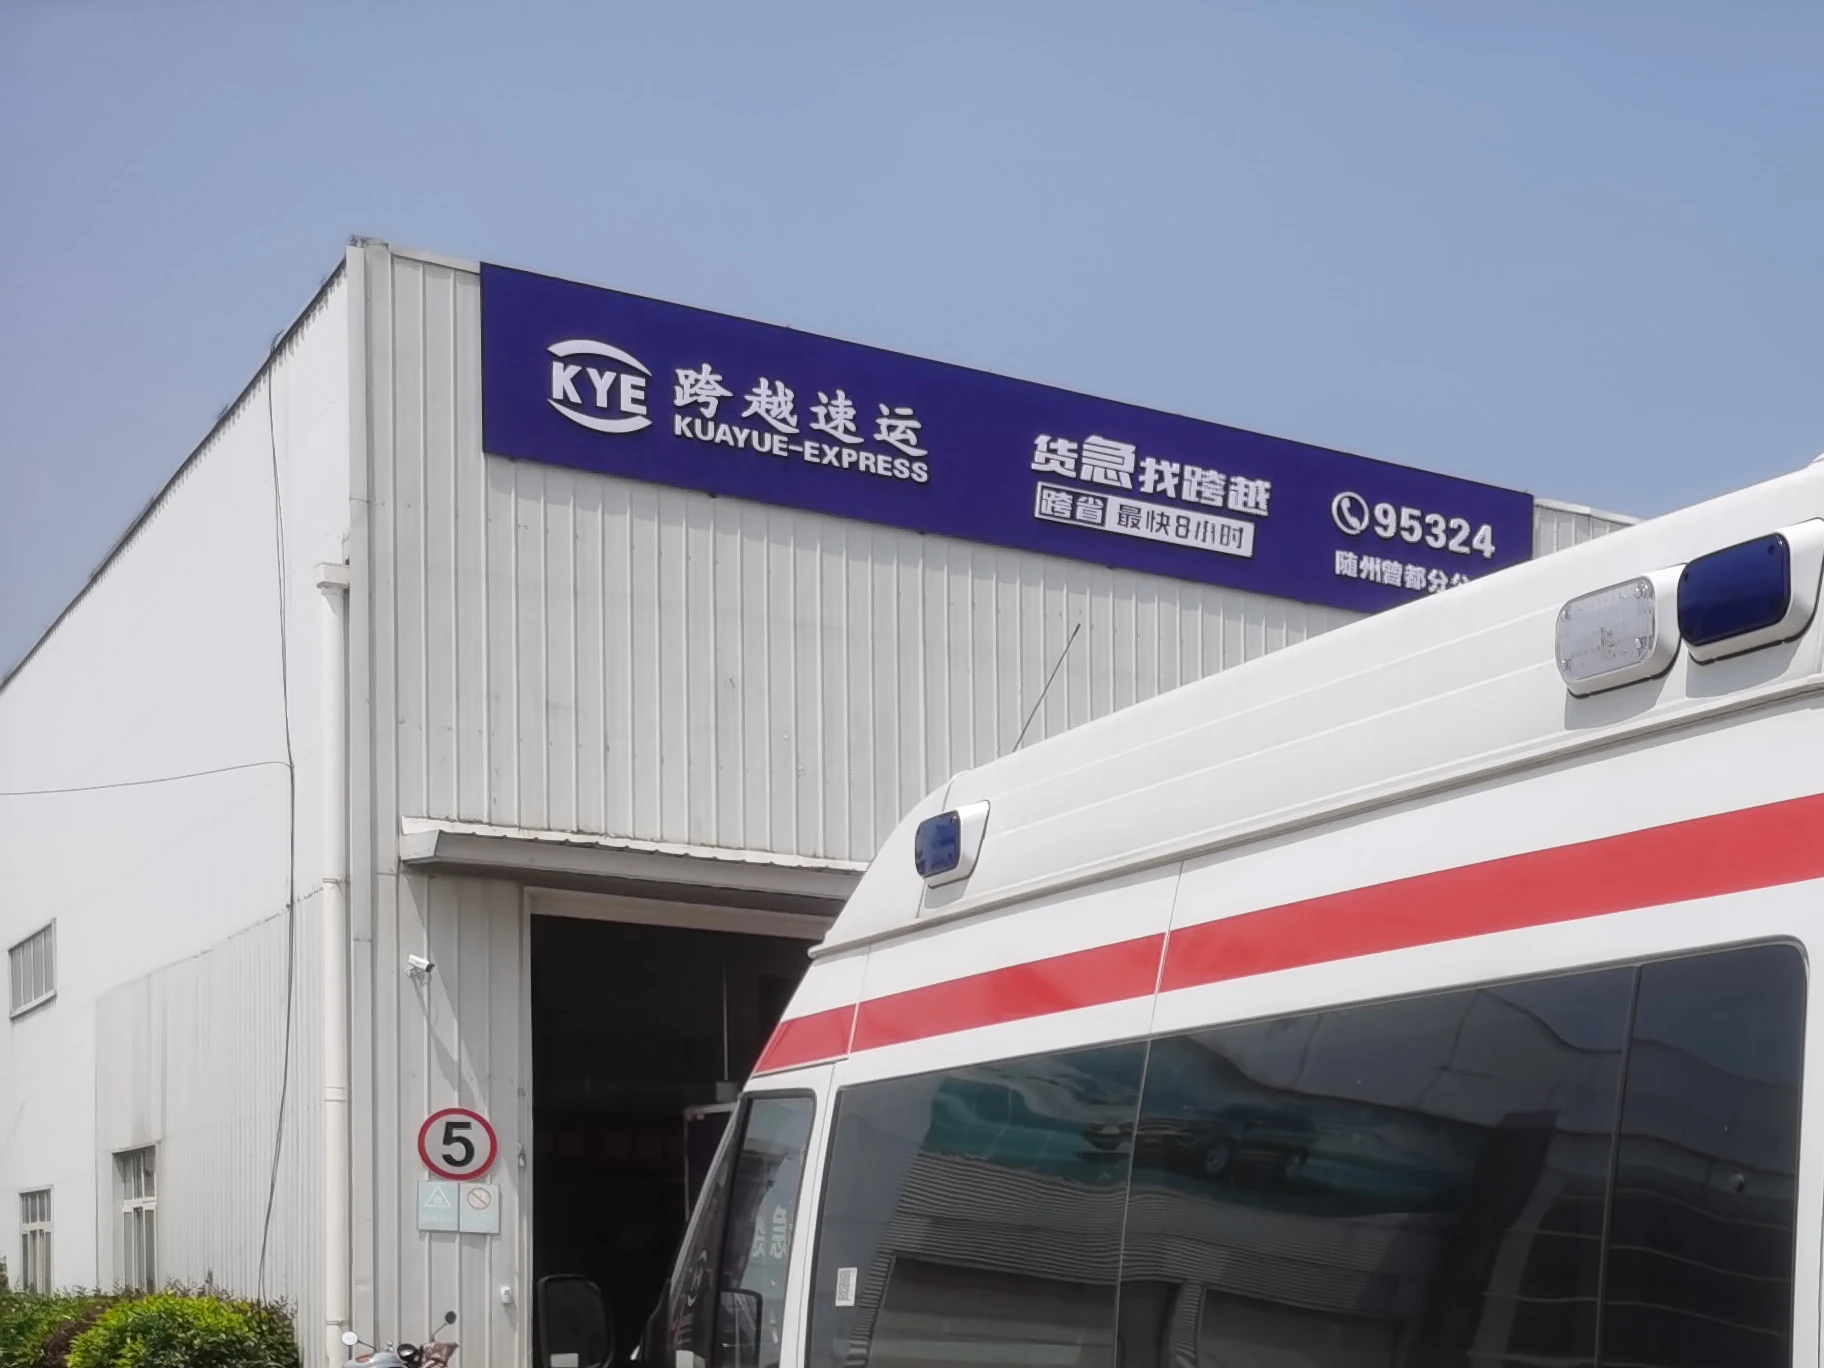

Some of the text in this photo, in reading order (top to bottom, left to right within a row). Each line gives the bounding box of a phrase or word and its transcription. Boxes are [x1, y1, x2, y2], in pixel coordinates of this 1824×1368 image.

[552, 361, 647, 415] KYE
[674, 363, 928, 457] 跨越速运
[674, 415, 929, 483] KUAYUE-EXPRESS
[1031, 434, 1272, 517] 货急找跨越
[1373, 502, 1496, 559] 95324
[441, 1121, 475, 1167] 5
